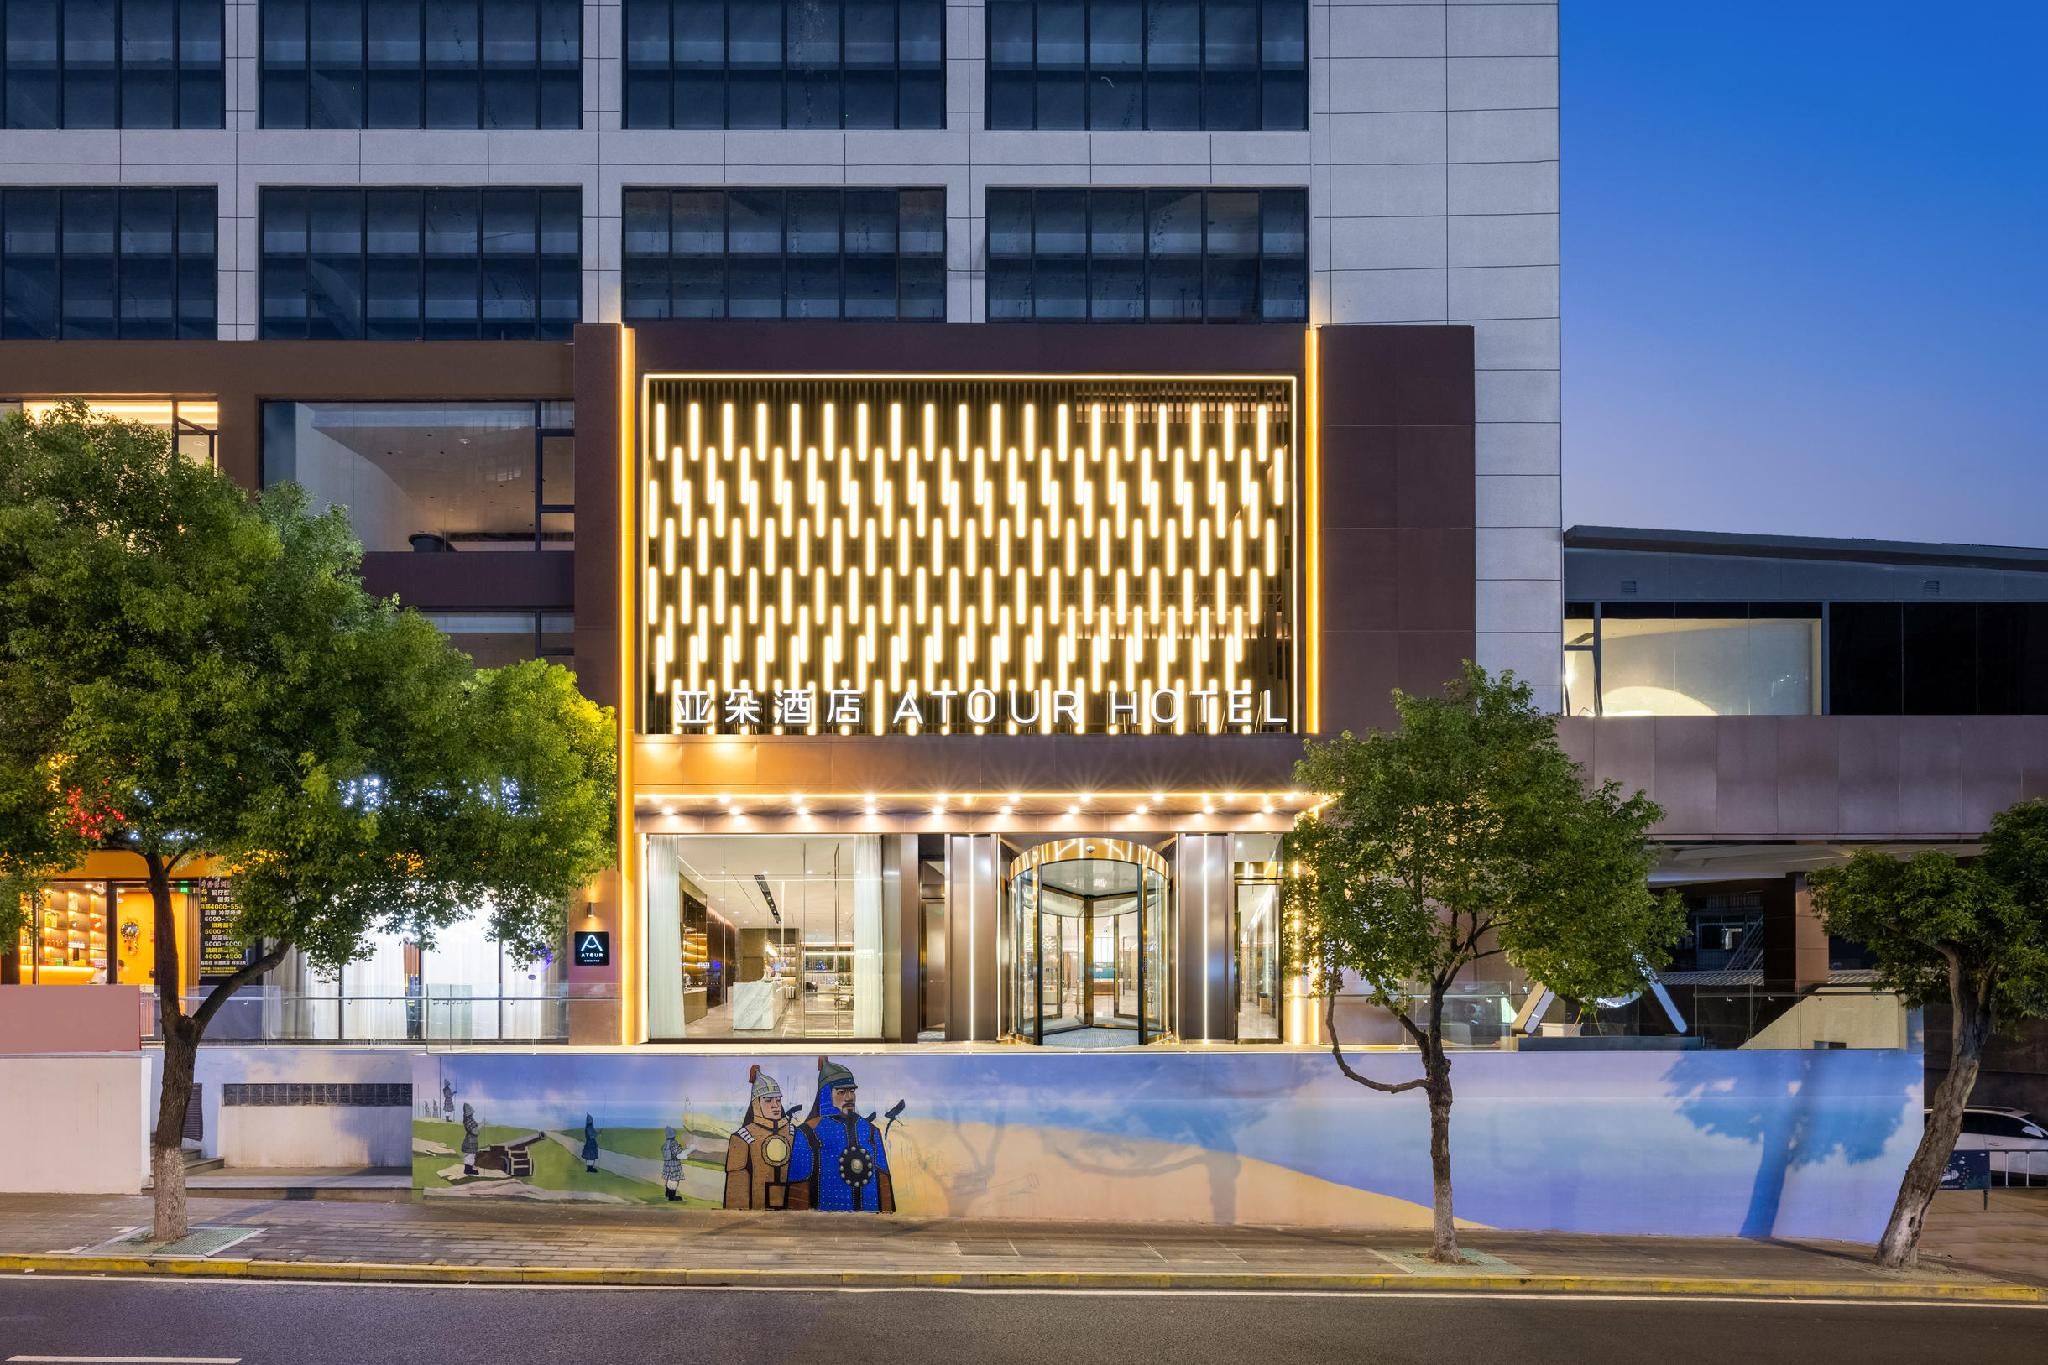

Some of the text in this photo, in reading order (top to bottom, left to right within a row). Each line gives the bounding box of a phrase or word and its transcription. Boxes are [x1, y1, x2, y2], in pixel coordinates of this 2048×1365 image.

[674, 688, 1288, 724] 亚朵酒店 ATOUR HOTEL
